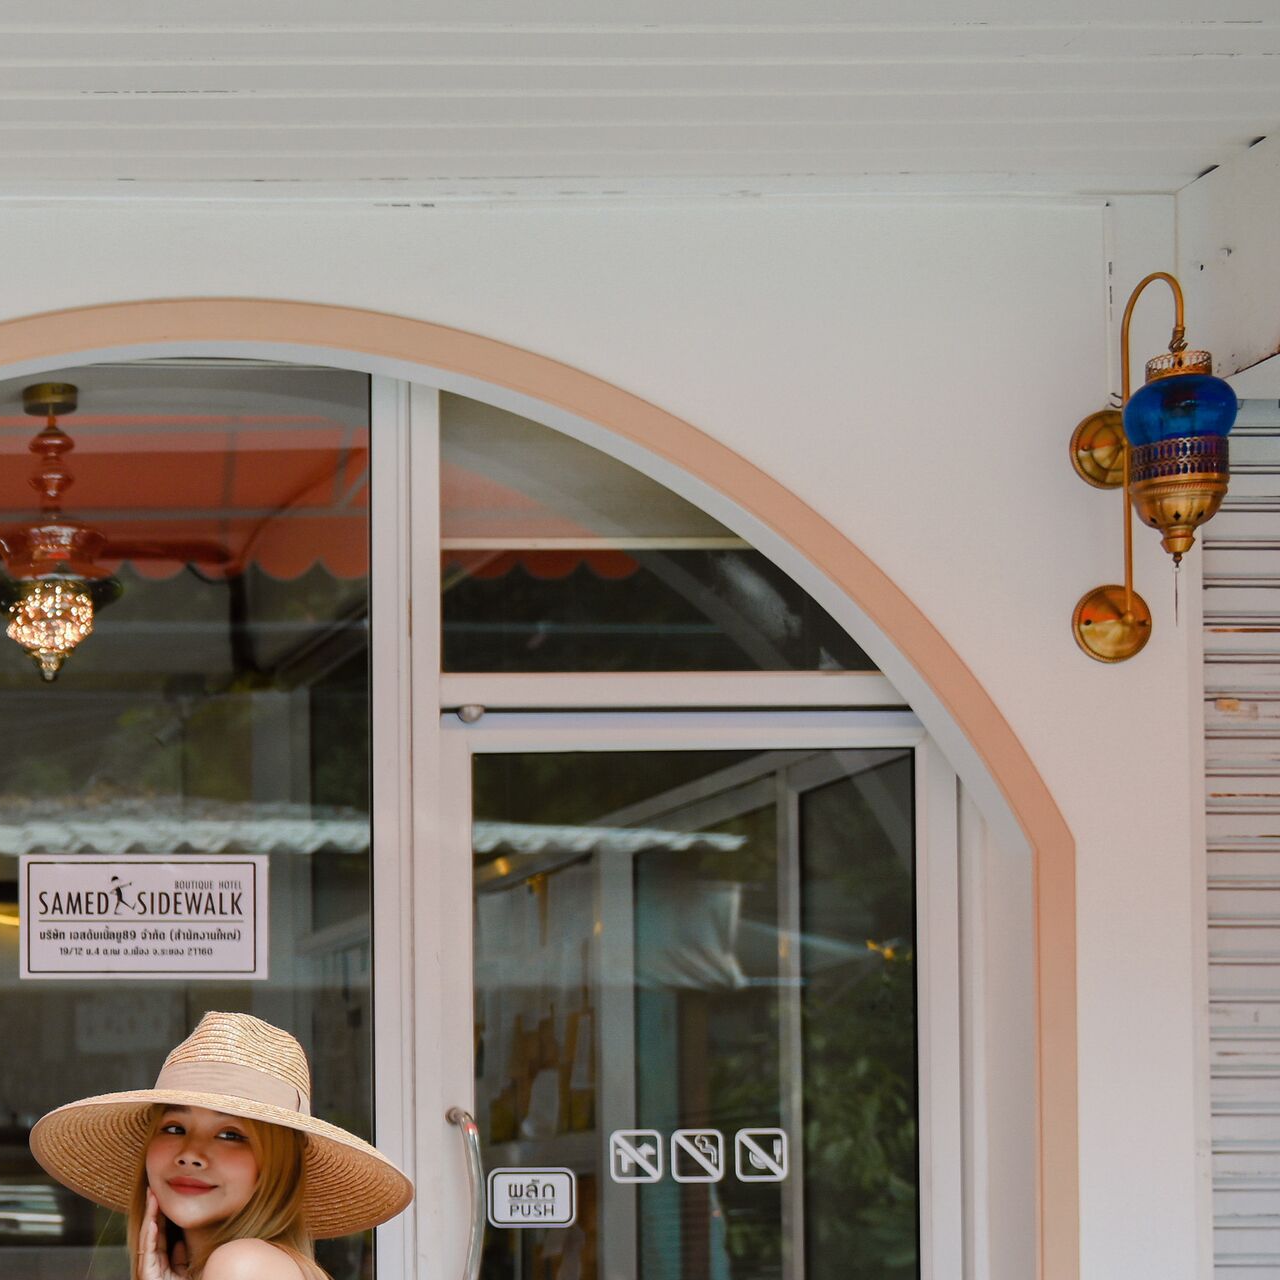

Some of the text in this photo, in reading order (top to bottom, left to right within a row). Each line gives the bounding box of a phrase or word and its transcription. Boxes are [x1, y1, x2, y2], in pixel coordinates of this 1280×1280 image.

[175, 880, 242, 890] BOUTIQUE HOTEL
[38, 891, 243, 915] SAMED SIDEWALK
[40, 928, 65, 940] บริษัท
[141, 928, 165, 940] จำกัด
[170, 928, 241, 942] (สำนักงานใหญ่)
[60, 947, 83, 956] 19/12
[508, 1179, 555, 1198] ผลัก
[509, 1204, 555, 1217] PUSH
